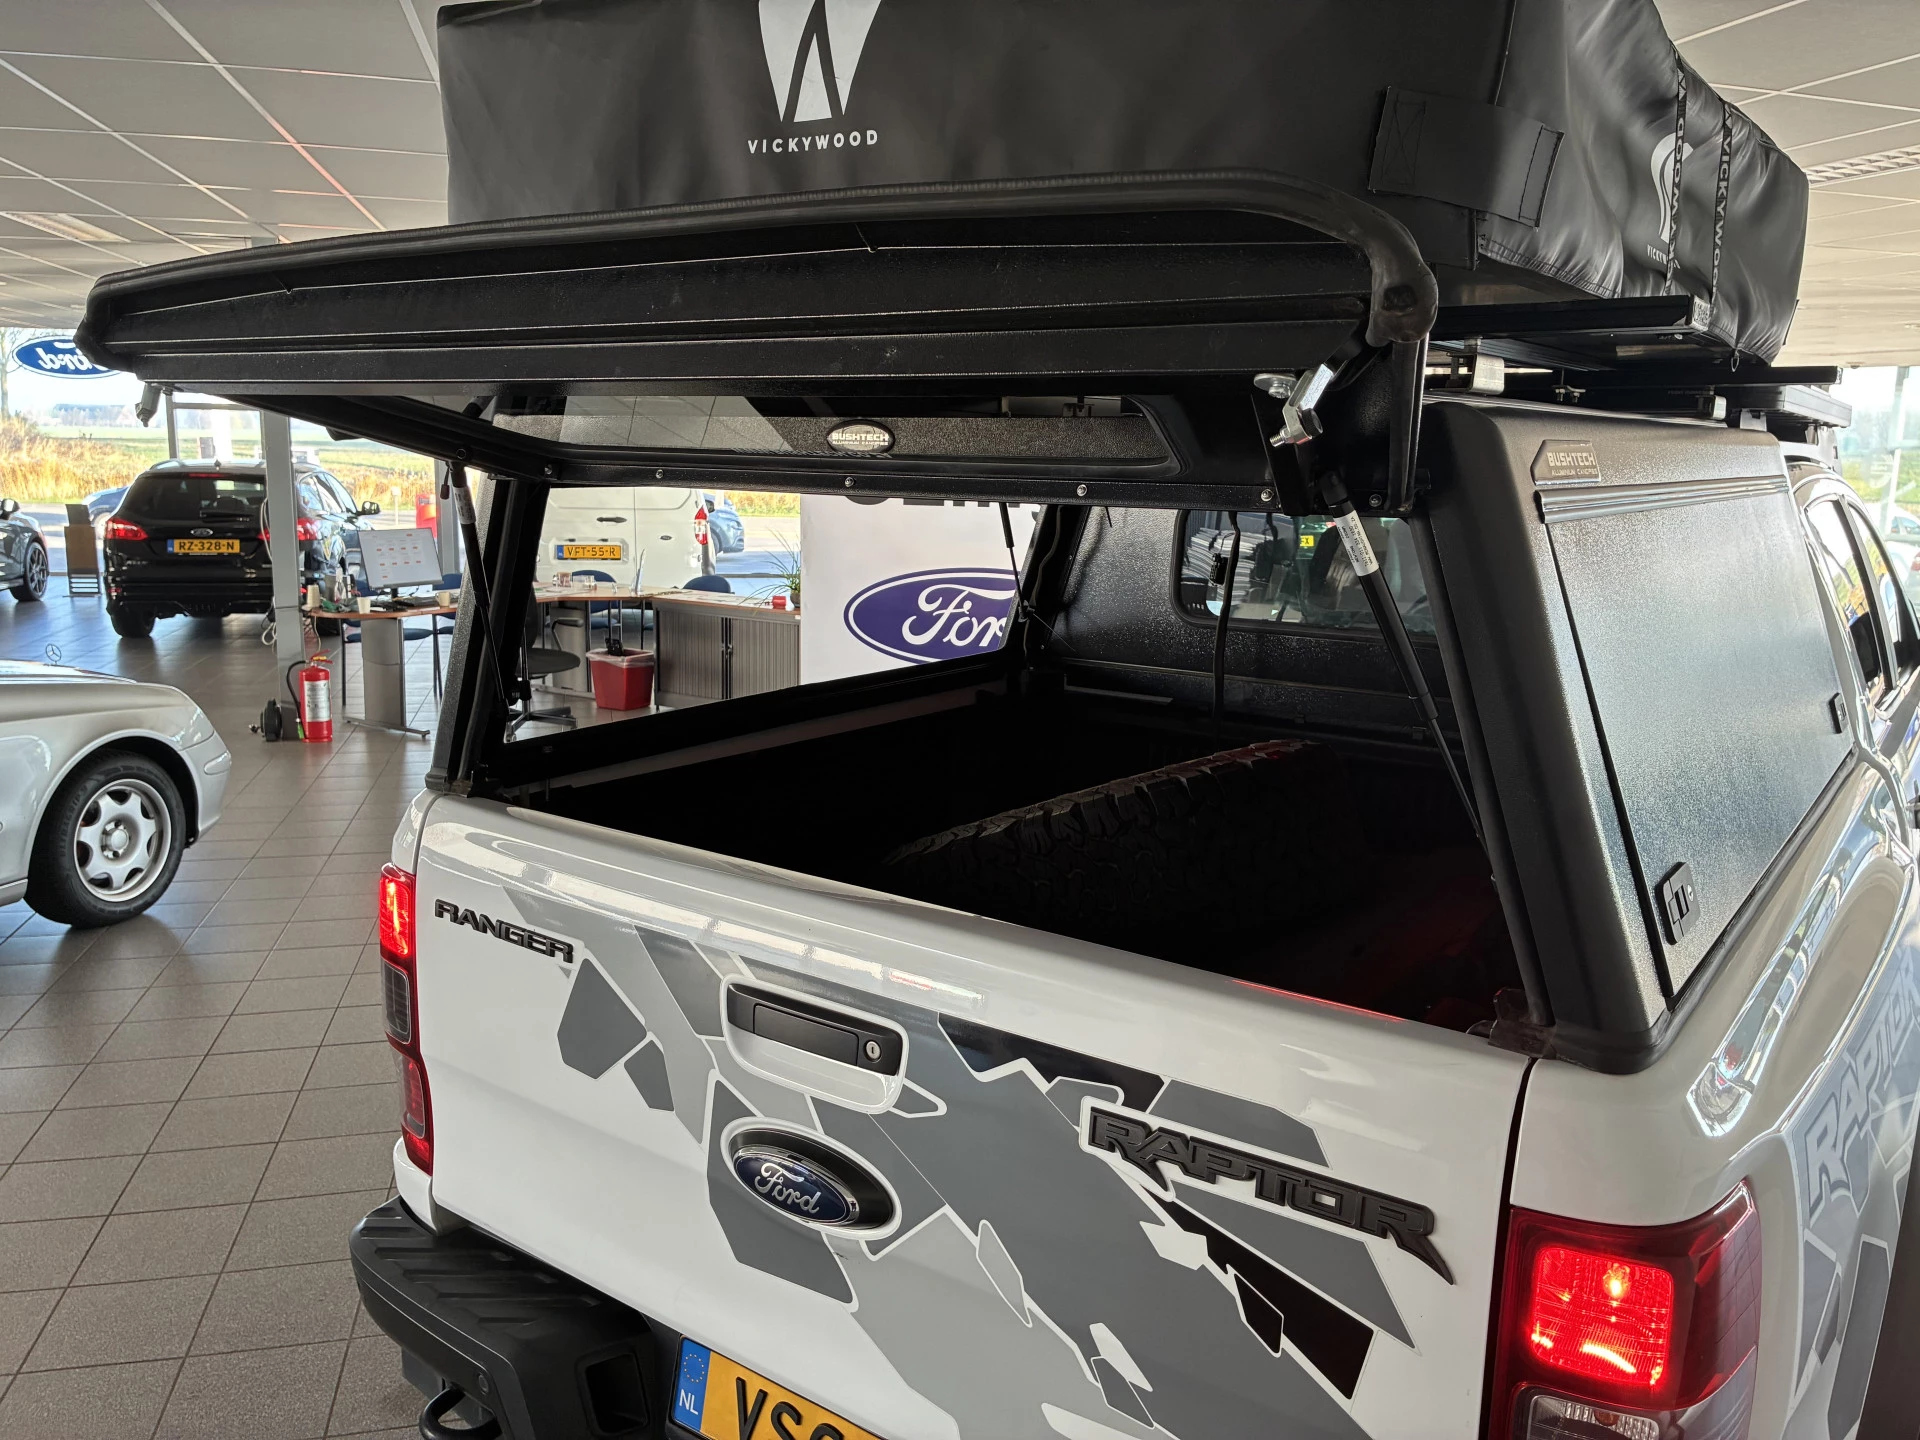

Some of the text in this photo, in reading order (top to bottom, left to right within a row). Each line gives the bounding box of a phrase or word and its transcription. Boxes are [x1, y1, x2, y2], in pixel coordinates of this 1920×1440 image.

[748, 130, 878, 154] VICKYWOOD
[832, 432, 889, 441] BUSHTECH
[1546, 452, 1596, 467] BUSHTECH
[178, 540, 235, 551] RZ-328-N
[567, 546, 616, 557] VFT-55-R
[902, 583, 1017, 648] For
[434, 898, 574, 964] RANGER
[1804, 944, 1920, 1224] RAPTOR
[754, 1162, 823, 1214] Ford
[1087, 1106, 1454, 1286] RAPTOR
[679, 1388, 699, 1416] NL
